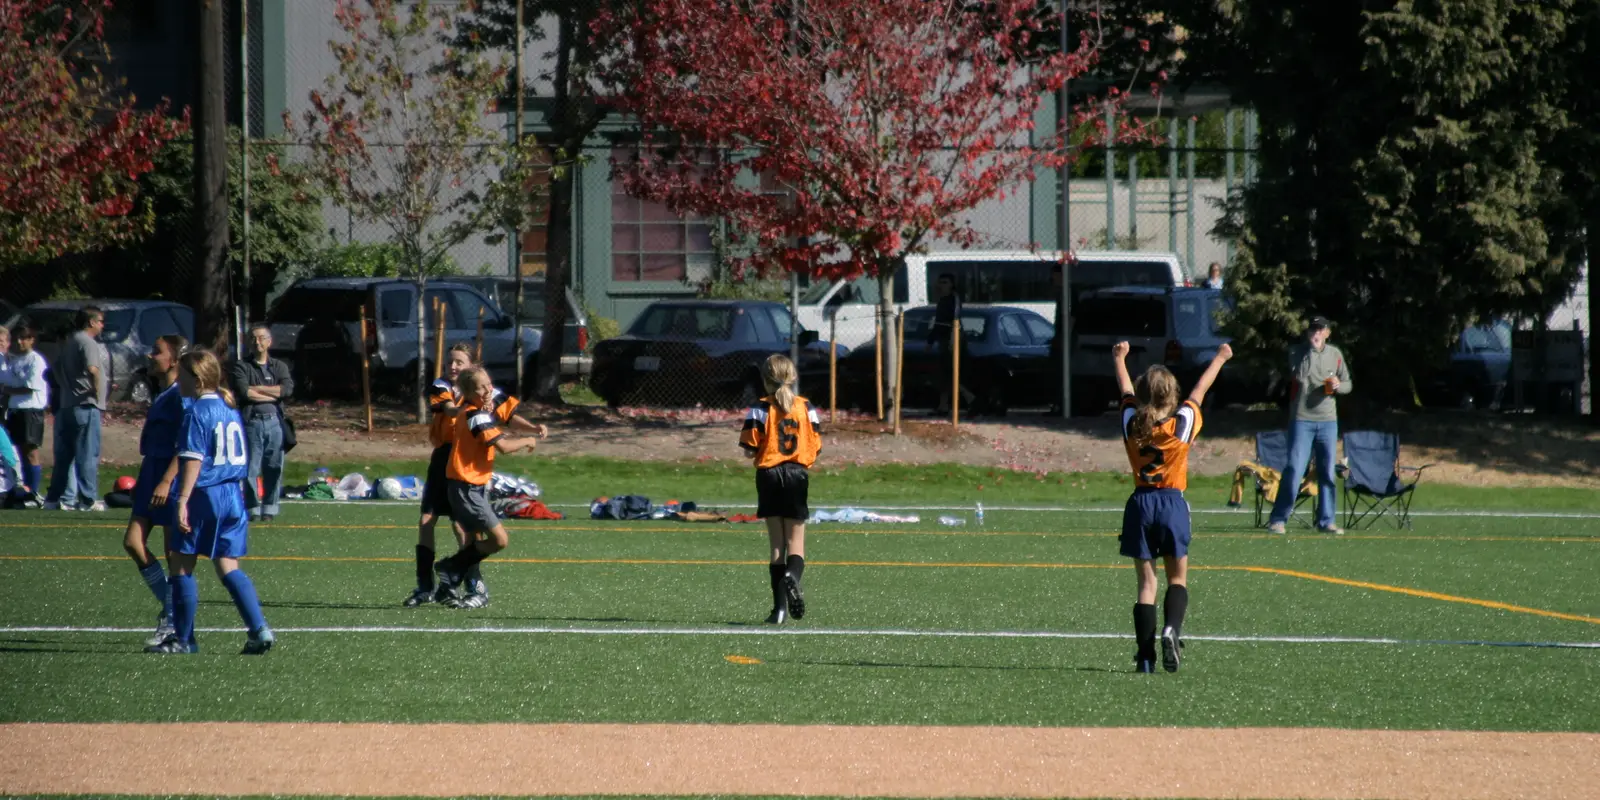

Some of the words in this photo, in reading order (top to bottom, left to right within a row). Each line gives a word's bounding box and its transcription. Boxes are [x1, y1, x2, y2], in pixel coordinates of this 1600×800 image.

[213, 421, 247, 466] 10
[778, 418, 799, 456] 6
[1139, 445, 1165, 483] 2
